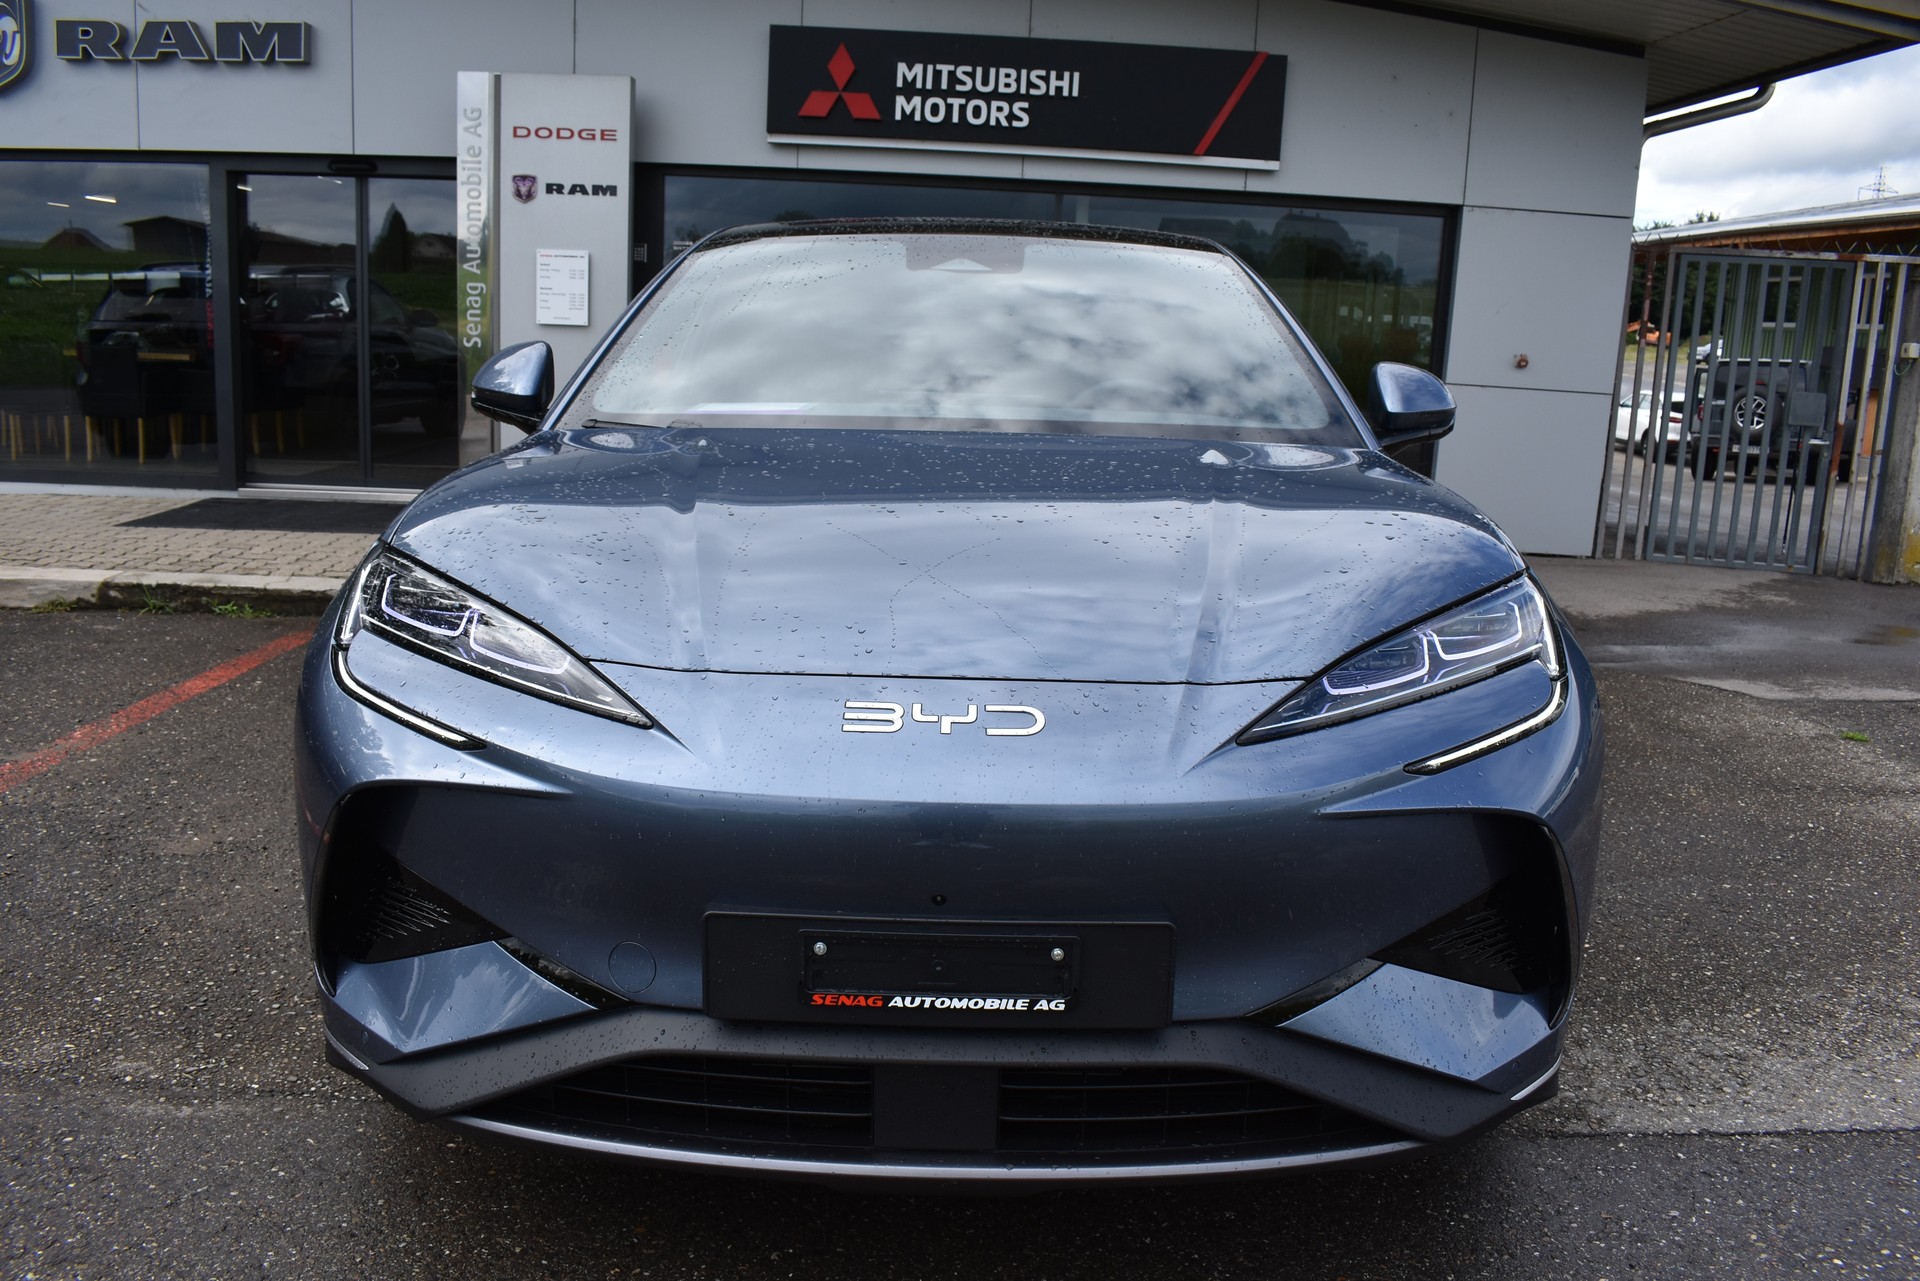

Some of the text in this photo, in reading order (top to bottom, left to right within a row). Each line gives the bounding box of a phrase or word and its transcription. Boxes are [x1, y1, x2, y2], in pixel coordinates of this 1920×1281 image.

[54, 18, 311, 63] RAM
[896, 62, 1080, 97] MITSUBISHI
[894, 95, 1030, 128] MOTORS
[512, 126, 618, 142] DODGE
[545, 182, 618, 197] RAM
[460, 106, 486, 348] Senag Automobile AG
[841, 700, 1046, 736] BYD
[810, 993, 1066, 1011] SENAG AUTOMOBILE AG
